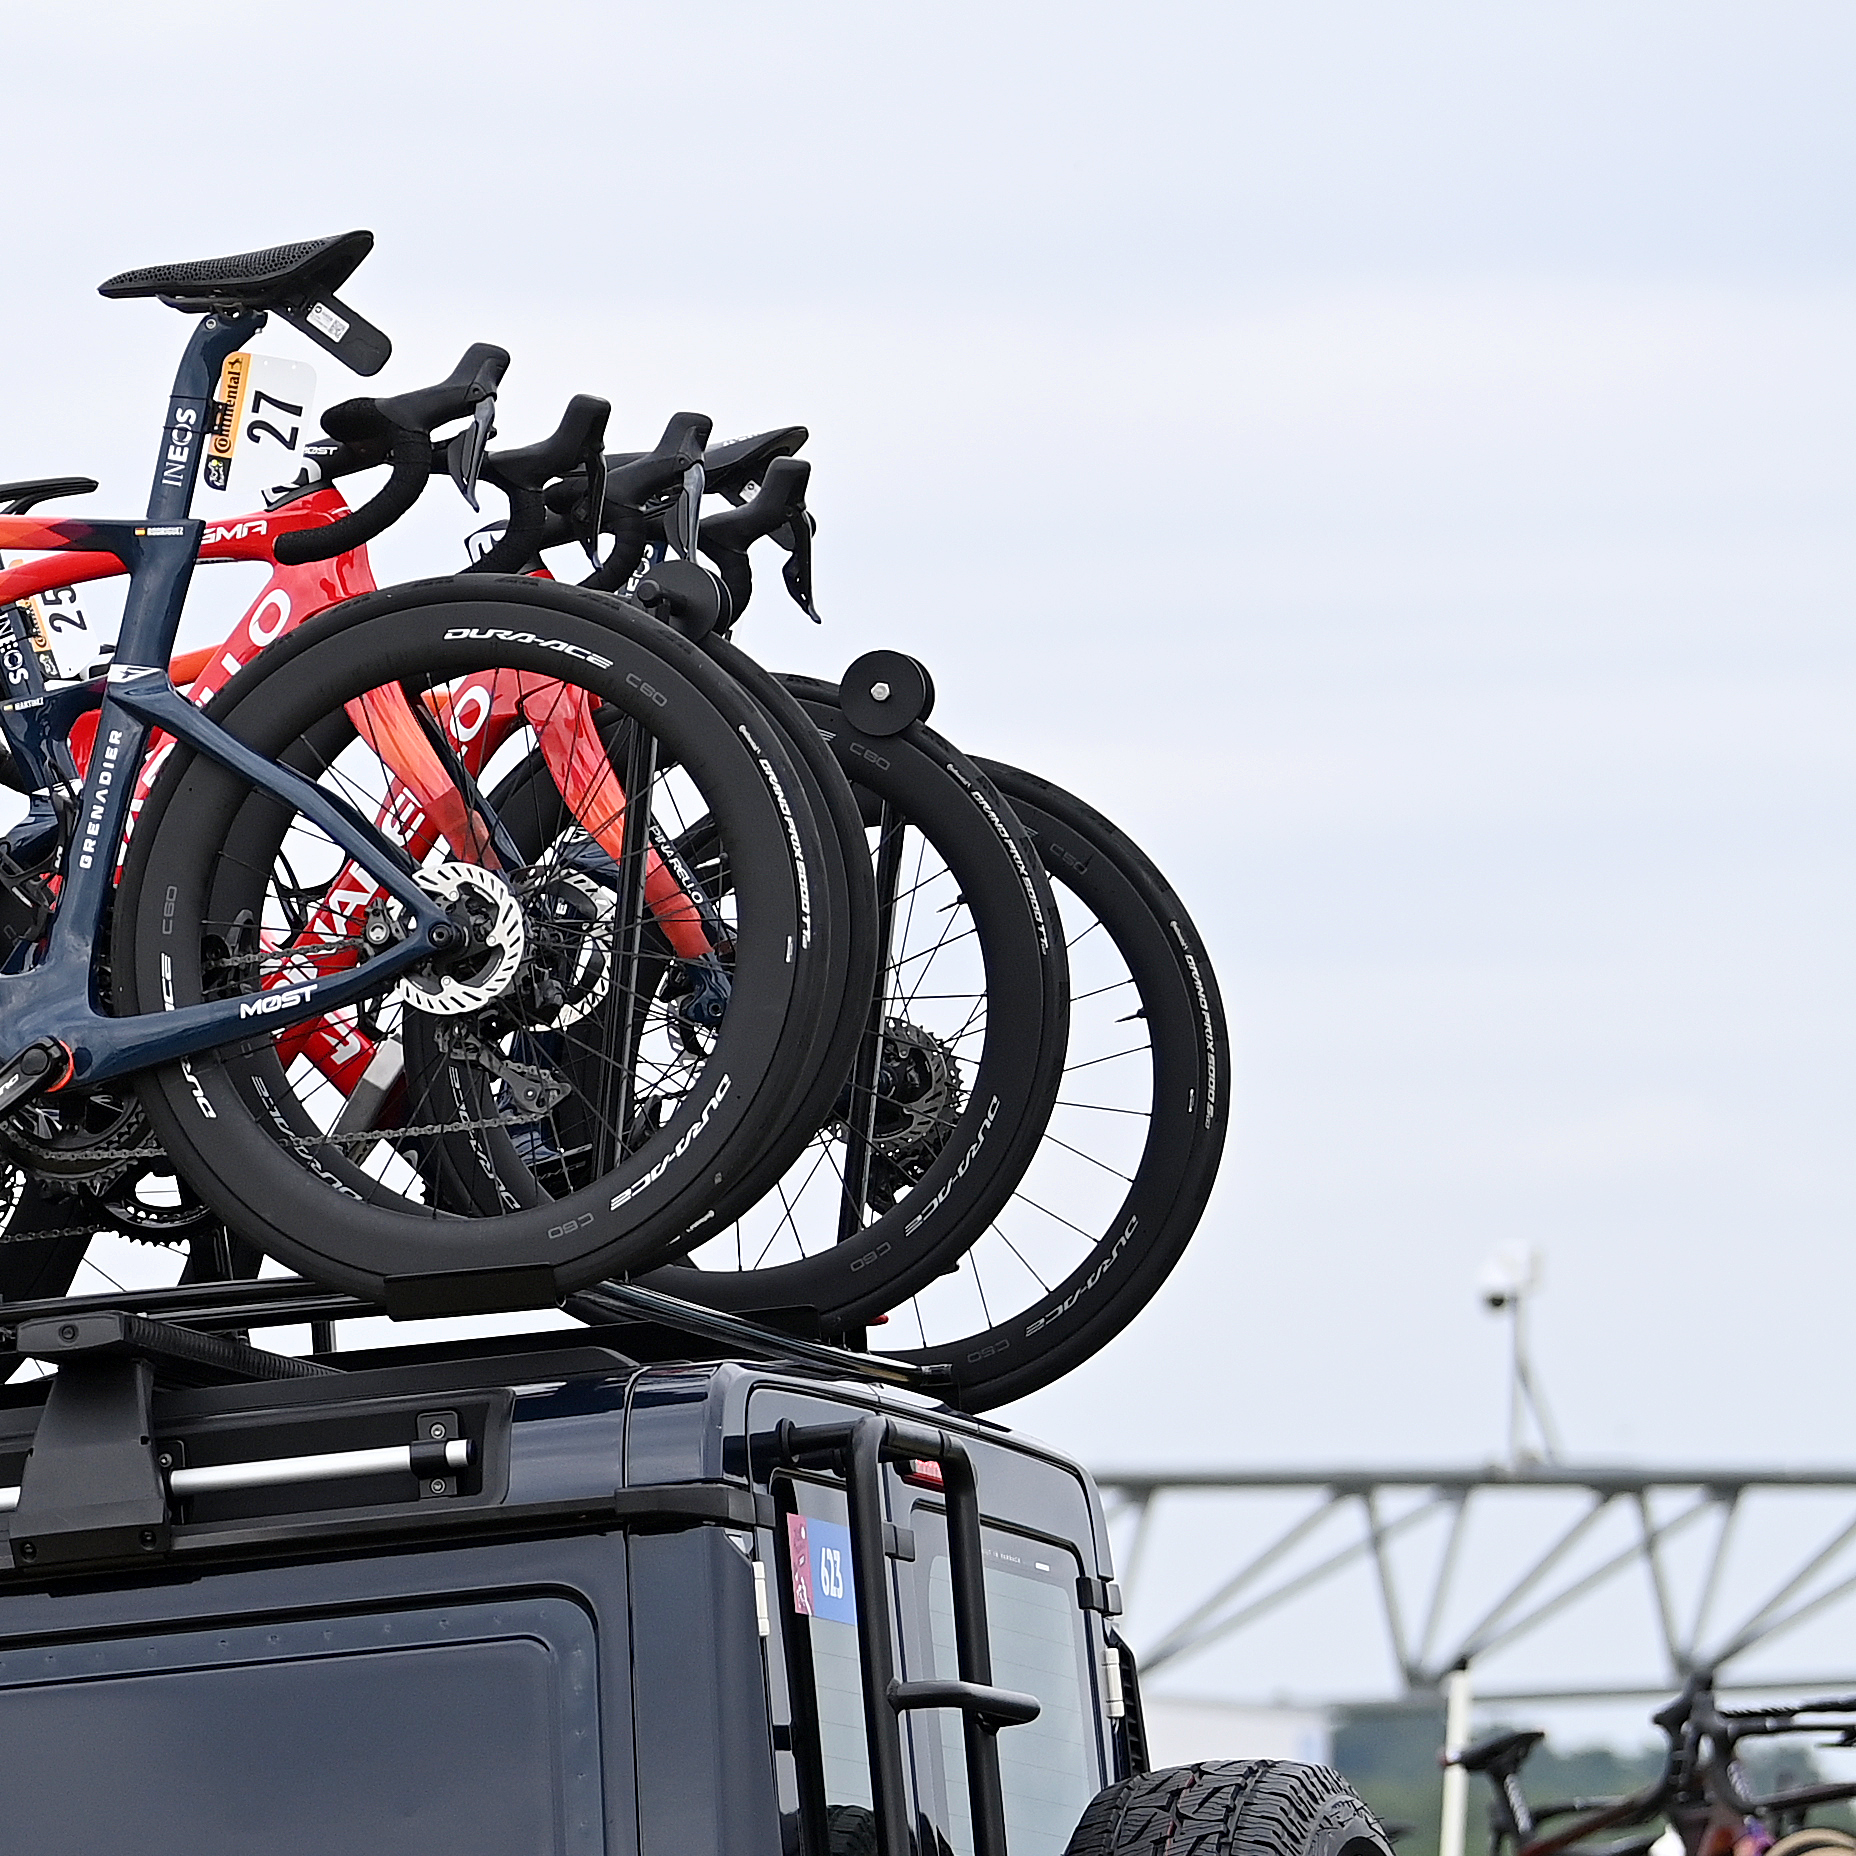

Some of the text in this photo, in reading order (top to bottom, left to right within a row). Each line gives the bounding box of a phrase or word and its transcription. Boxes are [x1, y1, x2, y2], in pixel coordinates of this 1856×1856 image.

[161, 406, 197, 489] INEOS
[246, 390, 304, 451] 27
[200, 519, 268, 546] GMA
[442, 626, 669, 708] DURA-ACE C60
[78, 729, 123, 869] GRENADIER
[757, 757, 792, 816] GRAND
[783, 815, 804, 861] PRIX
[795, 859, 811, 915] 5000
[648, 824, 705, 905] PINARELLO
[609, 1072, 733, 1213] DURA-ACE
[902, 1093, 1000, 1238] DURA-ACE
[1023, 1212, 1140, 1338] DURA-ACE
[819, 1546, 844, 1600] 623
